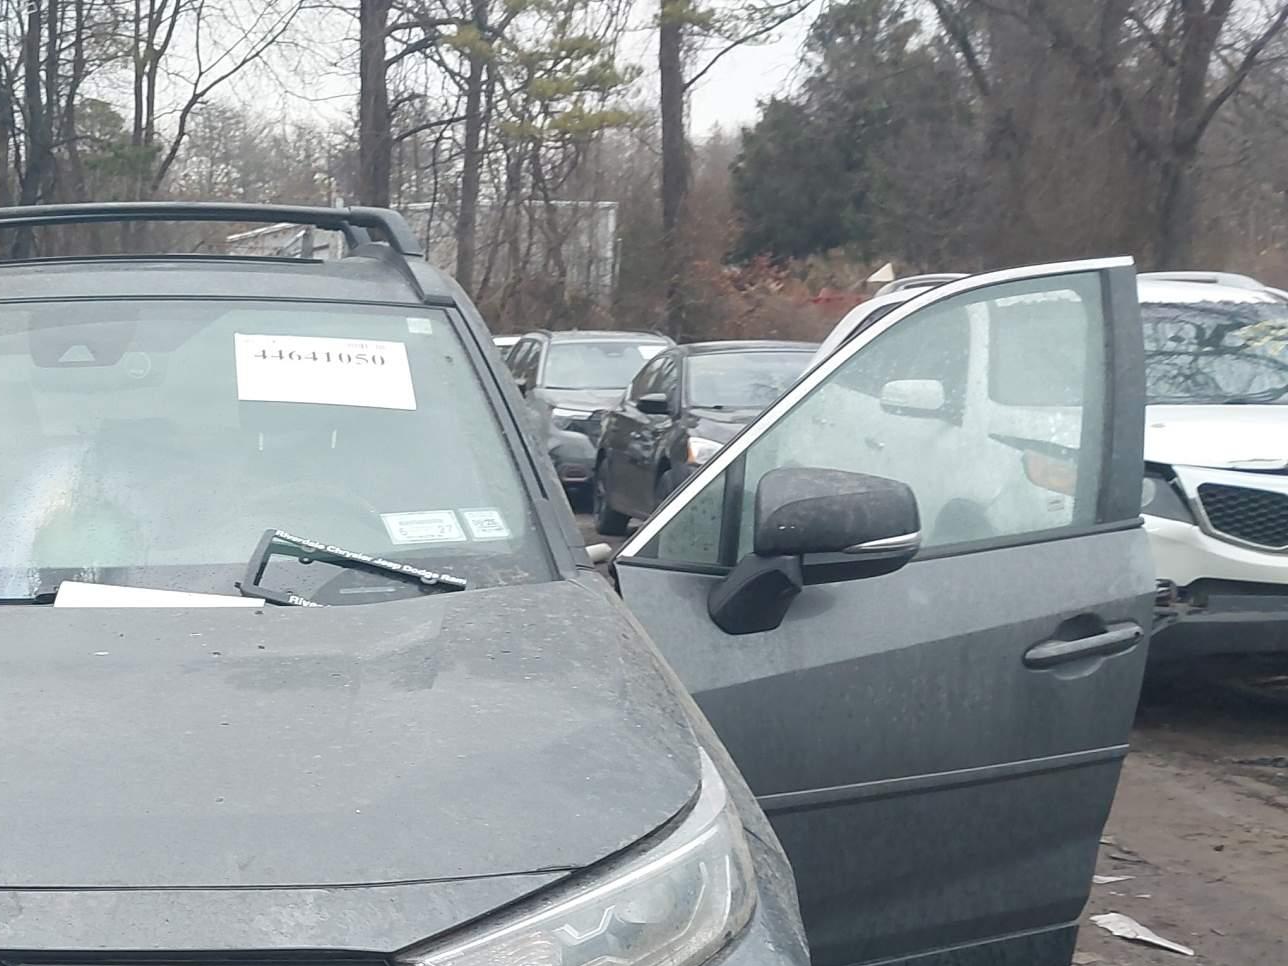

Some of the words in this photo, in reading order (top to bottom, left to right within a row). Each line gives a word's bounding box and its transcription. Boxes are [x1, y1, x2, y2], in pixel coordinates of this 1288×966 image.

[254, 349, 385, 366] 44641050
[275, 530, 326, 550] Riverdale
[326, 544, 374, 564] Chrysler
[373, 558, 402, 570] Jeep
[402, 565, 439, 579] Dodge
[440, 574, 467, 585] Ram
